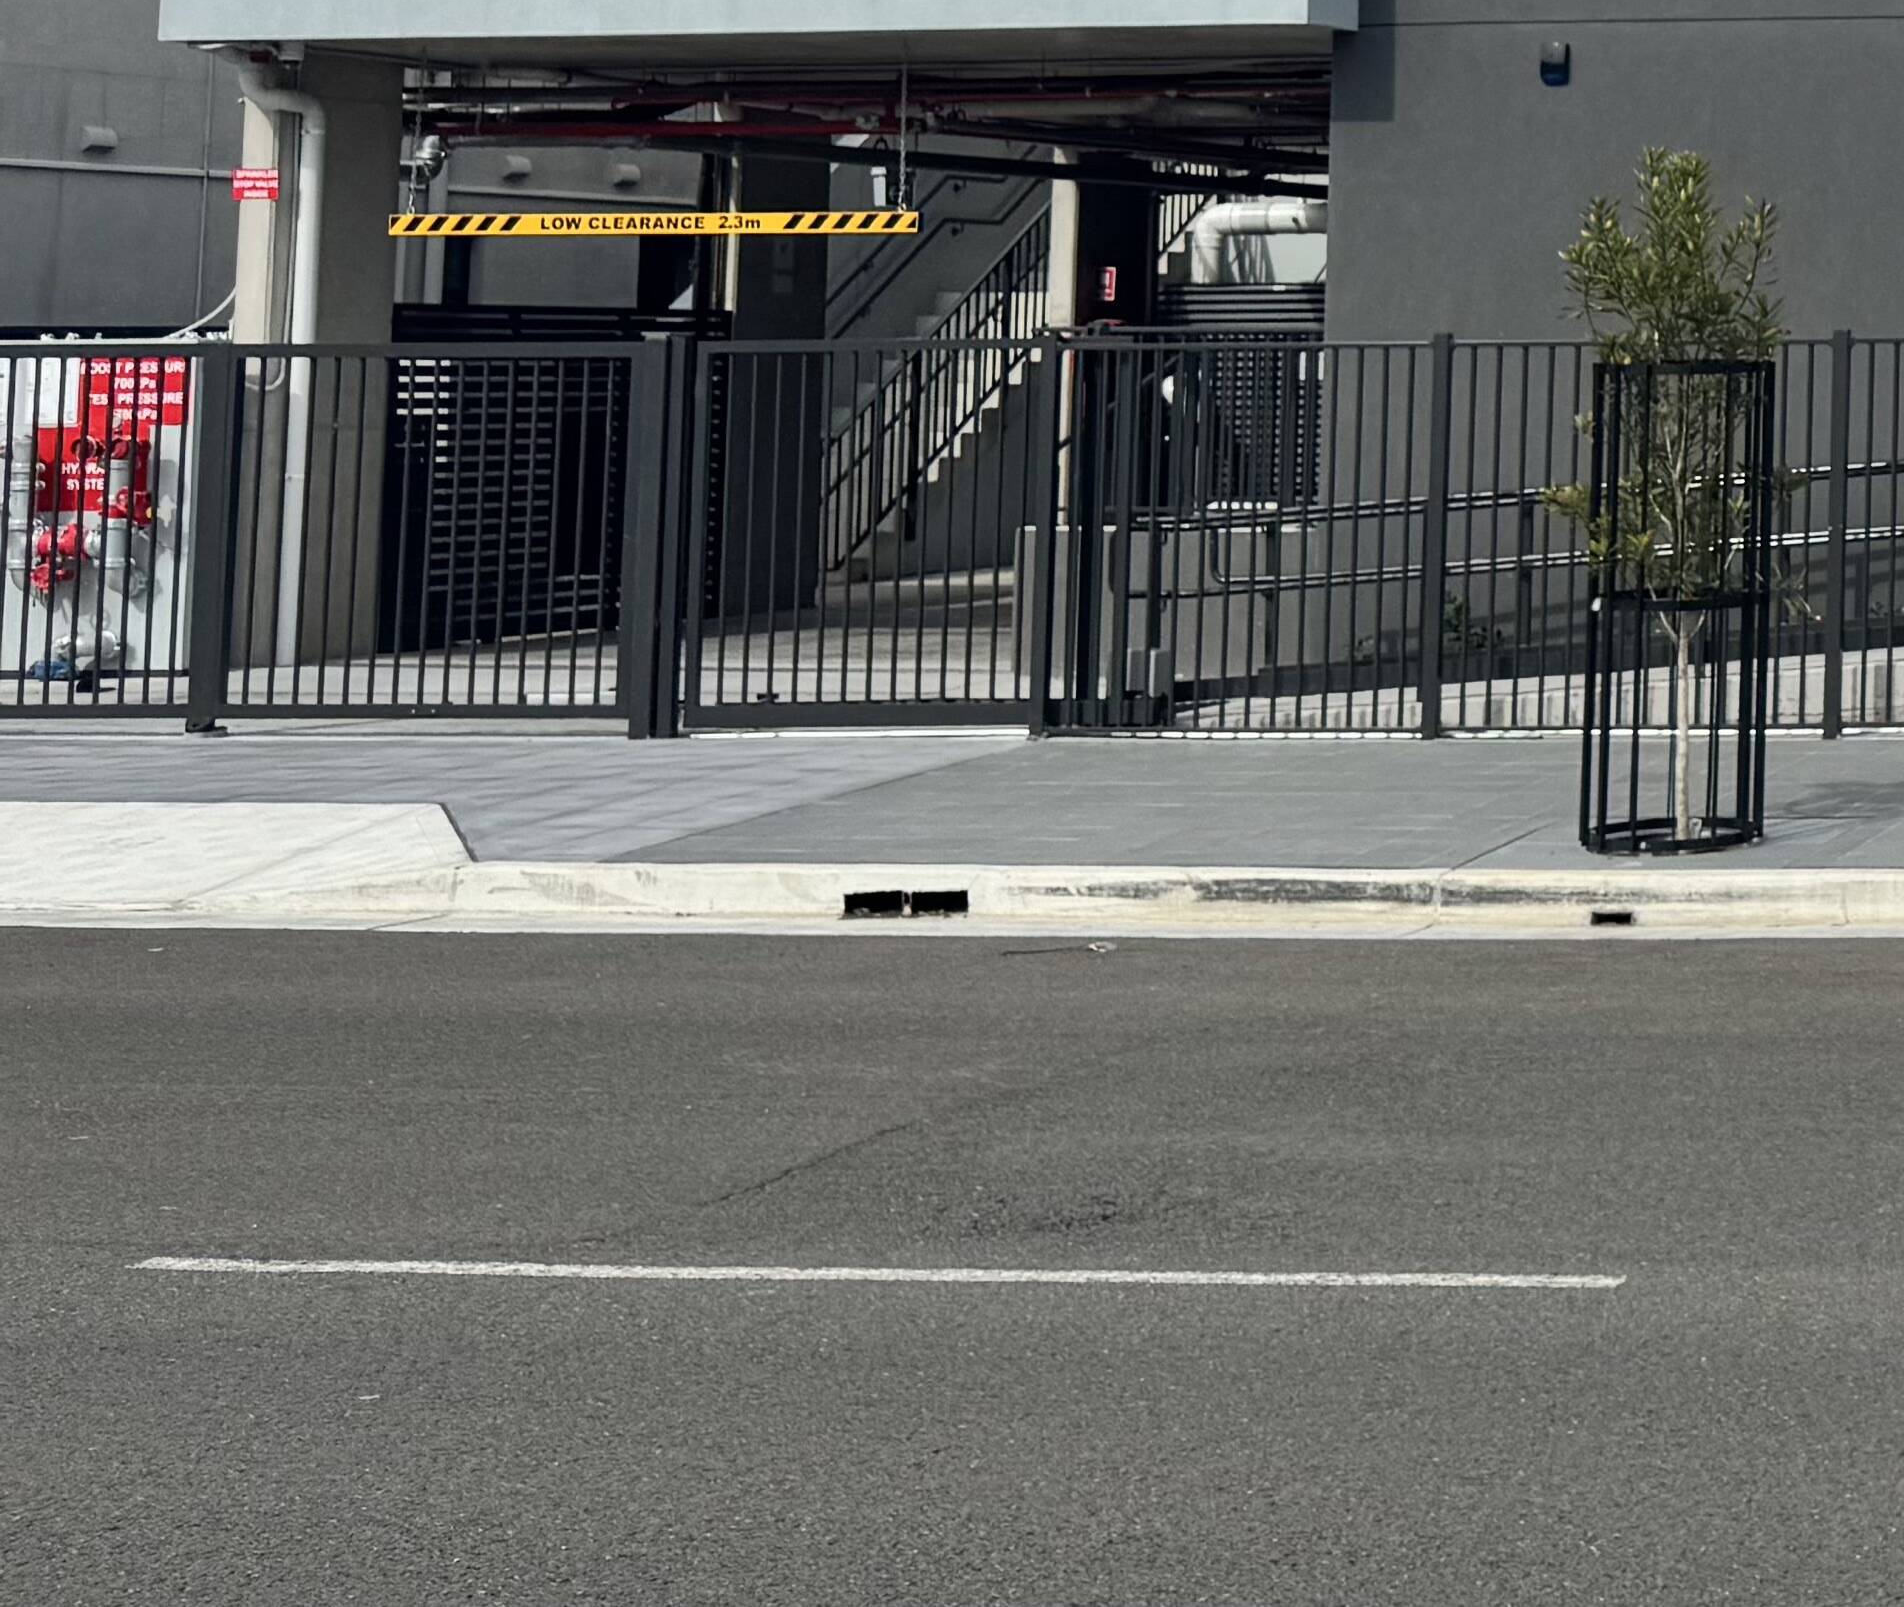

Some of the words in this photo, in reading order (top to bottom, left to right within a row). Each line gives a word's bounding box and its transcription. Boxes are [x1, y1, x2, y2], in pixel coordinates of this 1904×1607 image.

[541, 217, 582, 230] LOW
[589, 216, 705, 230] CLEARANCE
[719, 216, 761, 229] 2.3m
[114, 377, 157, 389] 700Pa
